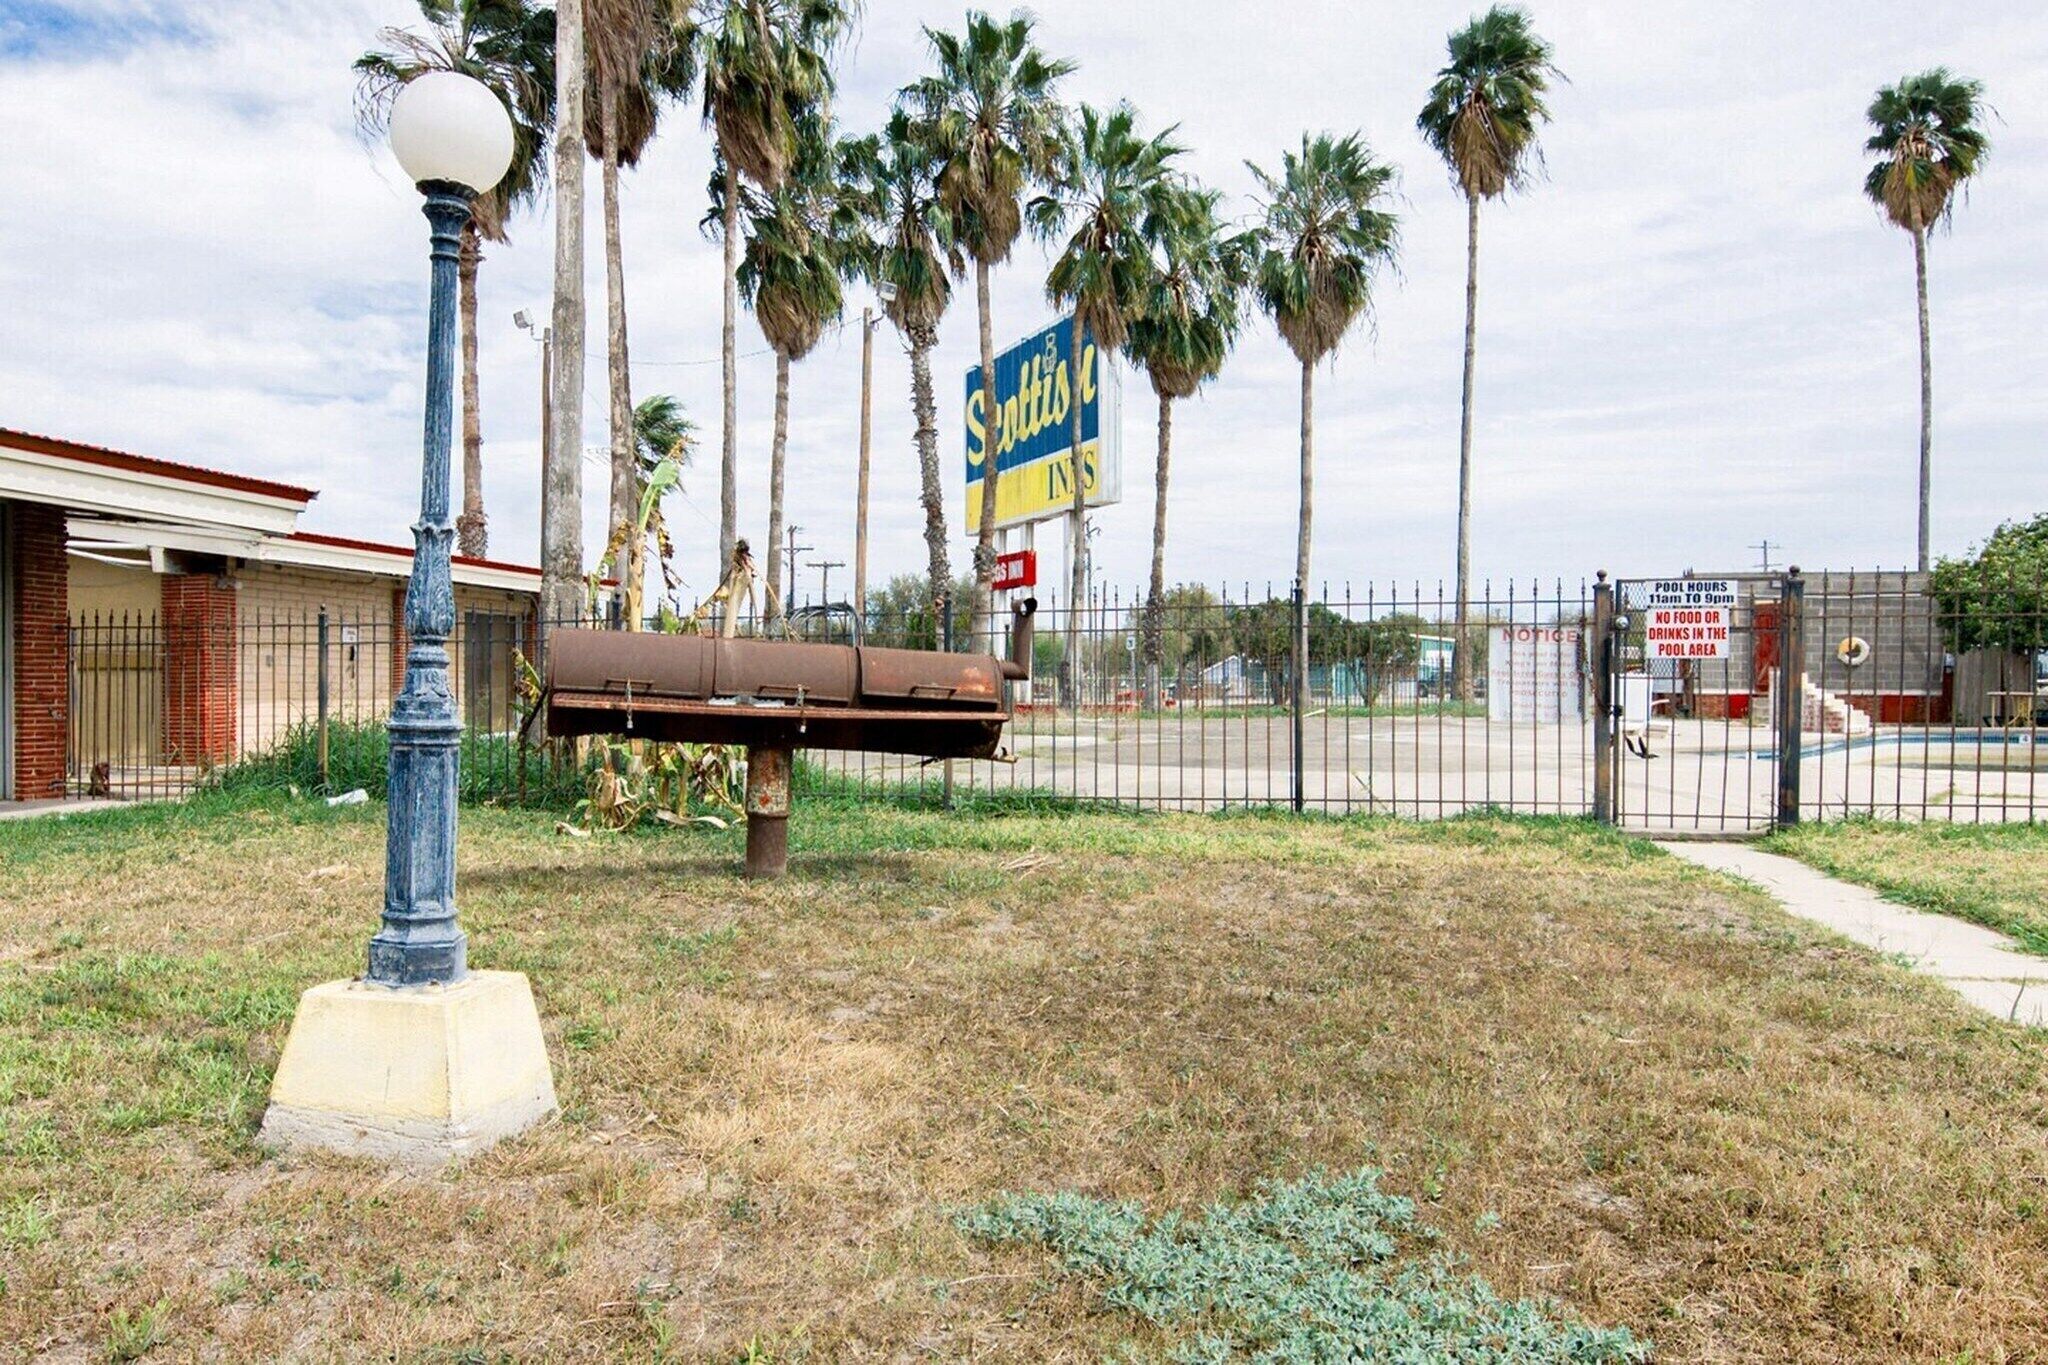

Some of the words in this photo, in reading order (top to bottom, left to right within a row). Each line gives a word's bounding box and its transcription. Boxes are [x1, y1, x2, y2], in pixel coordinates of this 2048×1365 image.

[1047, 450, 1095, 500] INS
[1655, 582, 1684, 592] POOL
[1687, 582, 1727, 592] HOURS
[1649, 594, 1681, 604] 11am
[1685, 594, 1699, 604] TO
[1705, 593, 1734, 604] 9pm
[1656, 611, 1670, 624] NO
[1673, 611, 1701, 624] FOOD
[1705, 611, 1720, 623] OR
[1502, 628, 1578, 642] NOTICE
[1649, 627, 1690, 640] DRINKS
[1693, 627, 1704, 640] IN
[1707, 627, 1727, 640] THE
[1658, 643, 1685, 656] POOL
[1688, 643, 1717, 656] AREA
